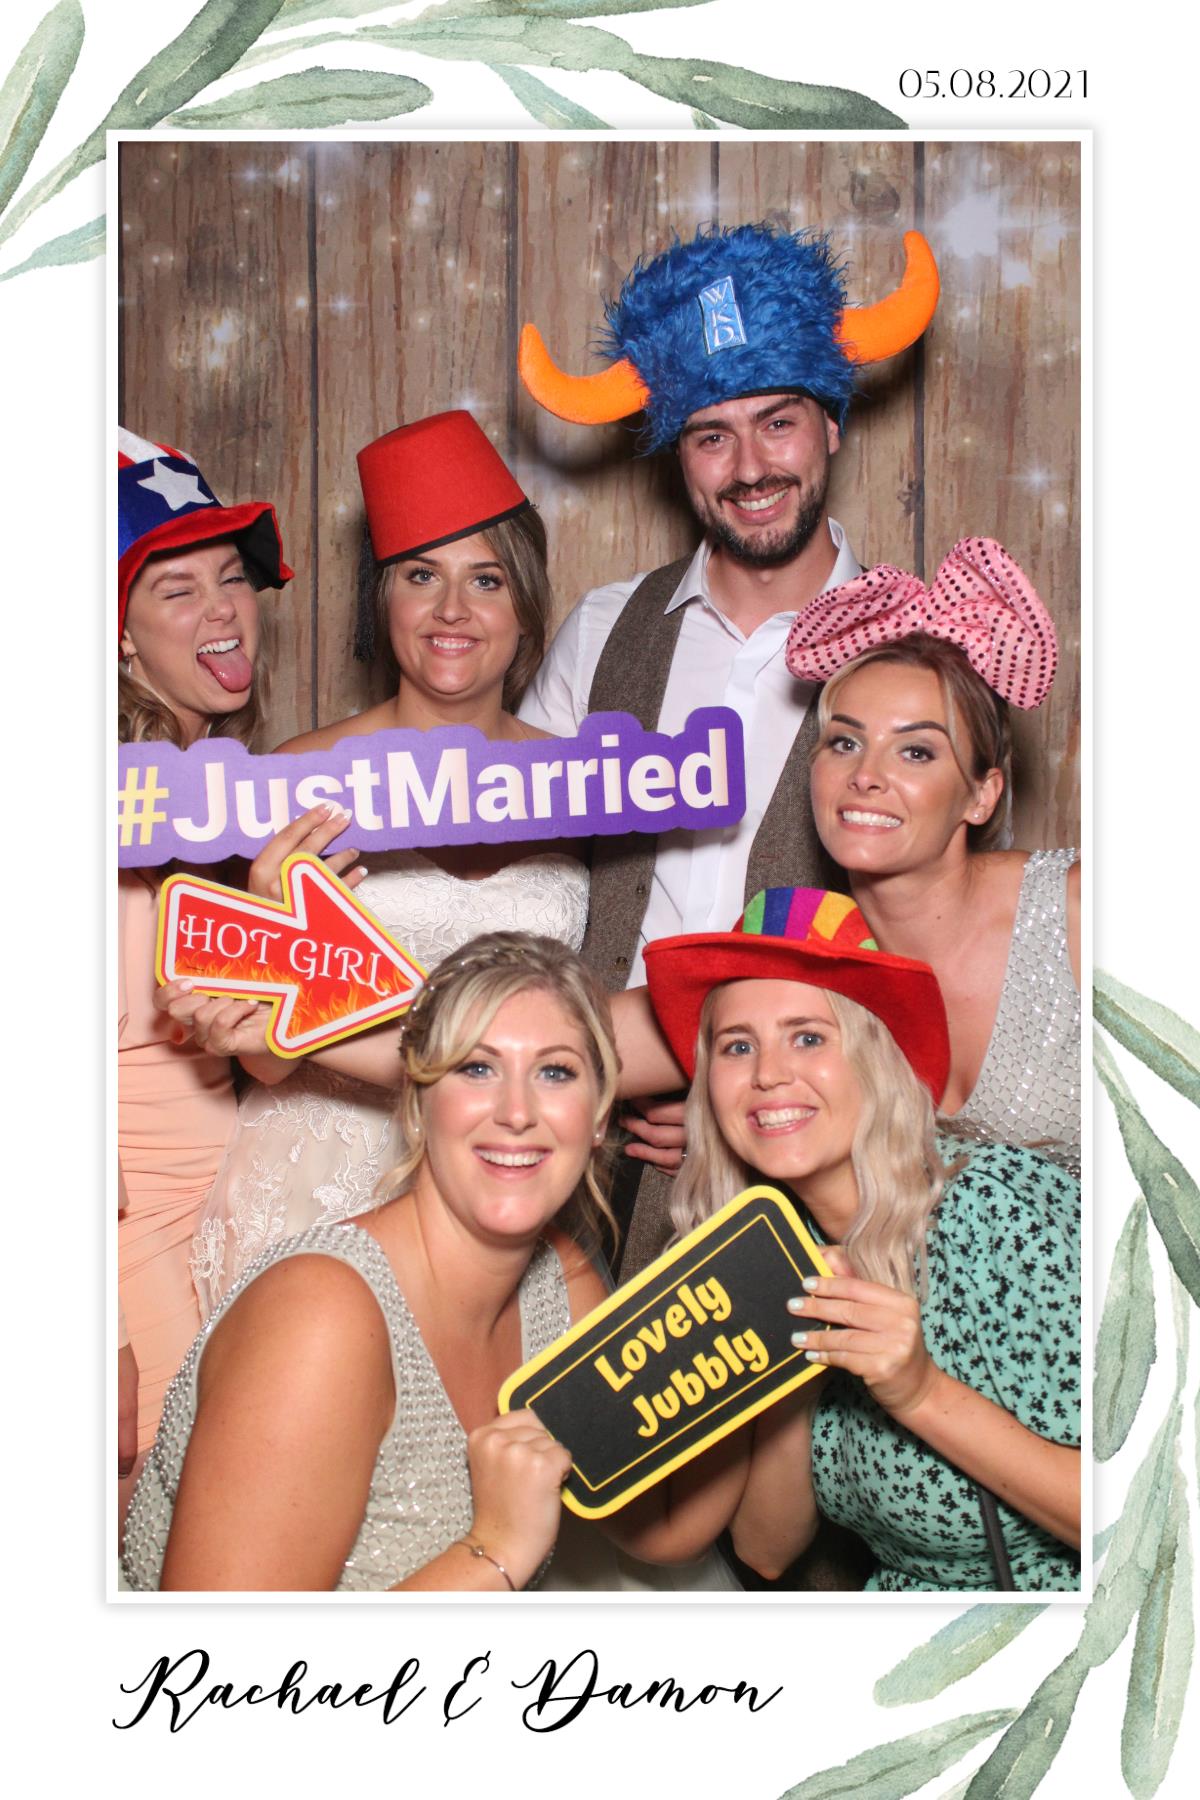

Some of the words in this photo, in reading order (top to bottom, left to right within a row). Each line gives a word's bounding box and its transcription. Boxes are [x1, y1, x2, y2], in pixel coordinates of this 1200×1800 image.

[703, 282, 735, 347] WKD
[118, 728, 729, 846] #JustMarried
[179, 914, 281, 965] HOT
[289, 938, 392, 996] GIRL
[594, 1276, 732, 1393] Lovely
[632, 1328, 770, 1438] Jubbly
